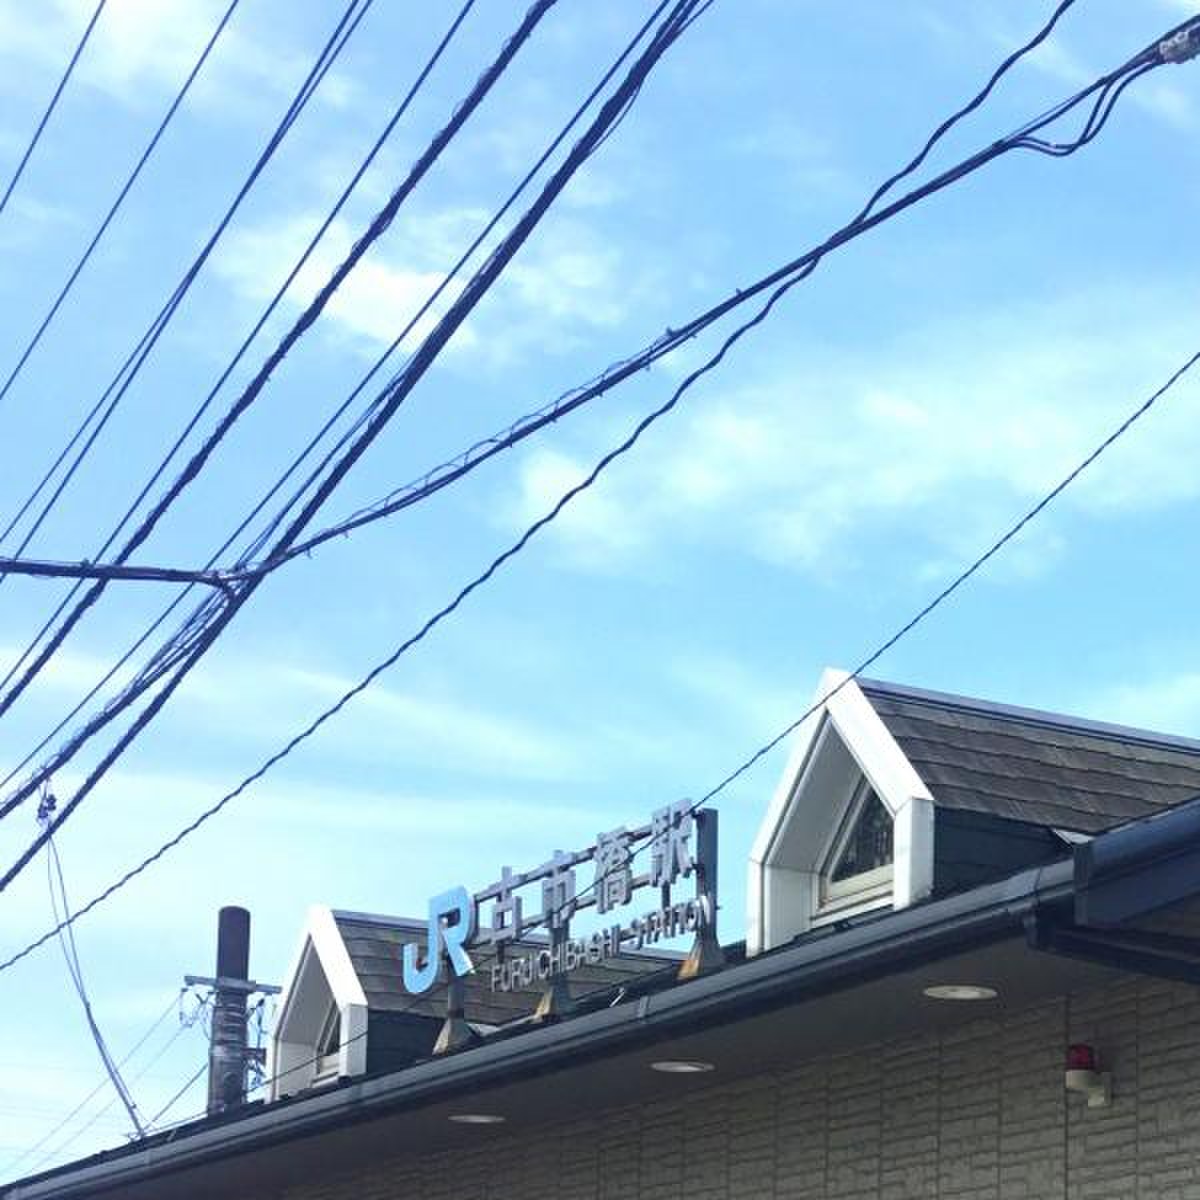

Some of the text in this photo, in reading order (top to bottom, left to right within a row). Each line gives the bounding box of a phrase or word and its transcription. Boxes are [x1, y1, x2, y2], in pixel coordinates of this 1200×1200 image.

[403, 799, 698, 993] JR 古市橋駅
[491, 924, 622, 993] FURUICHIBASHI
